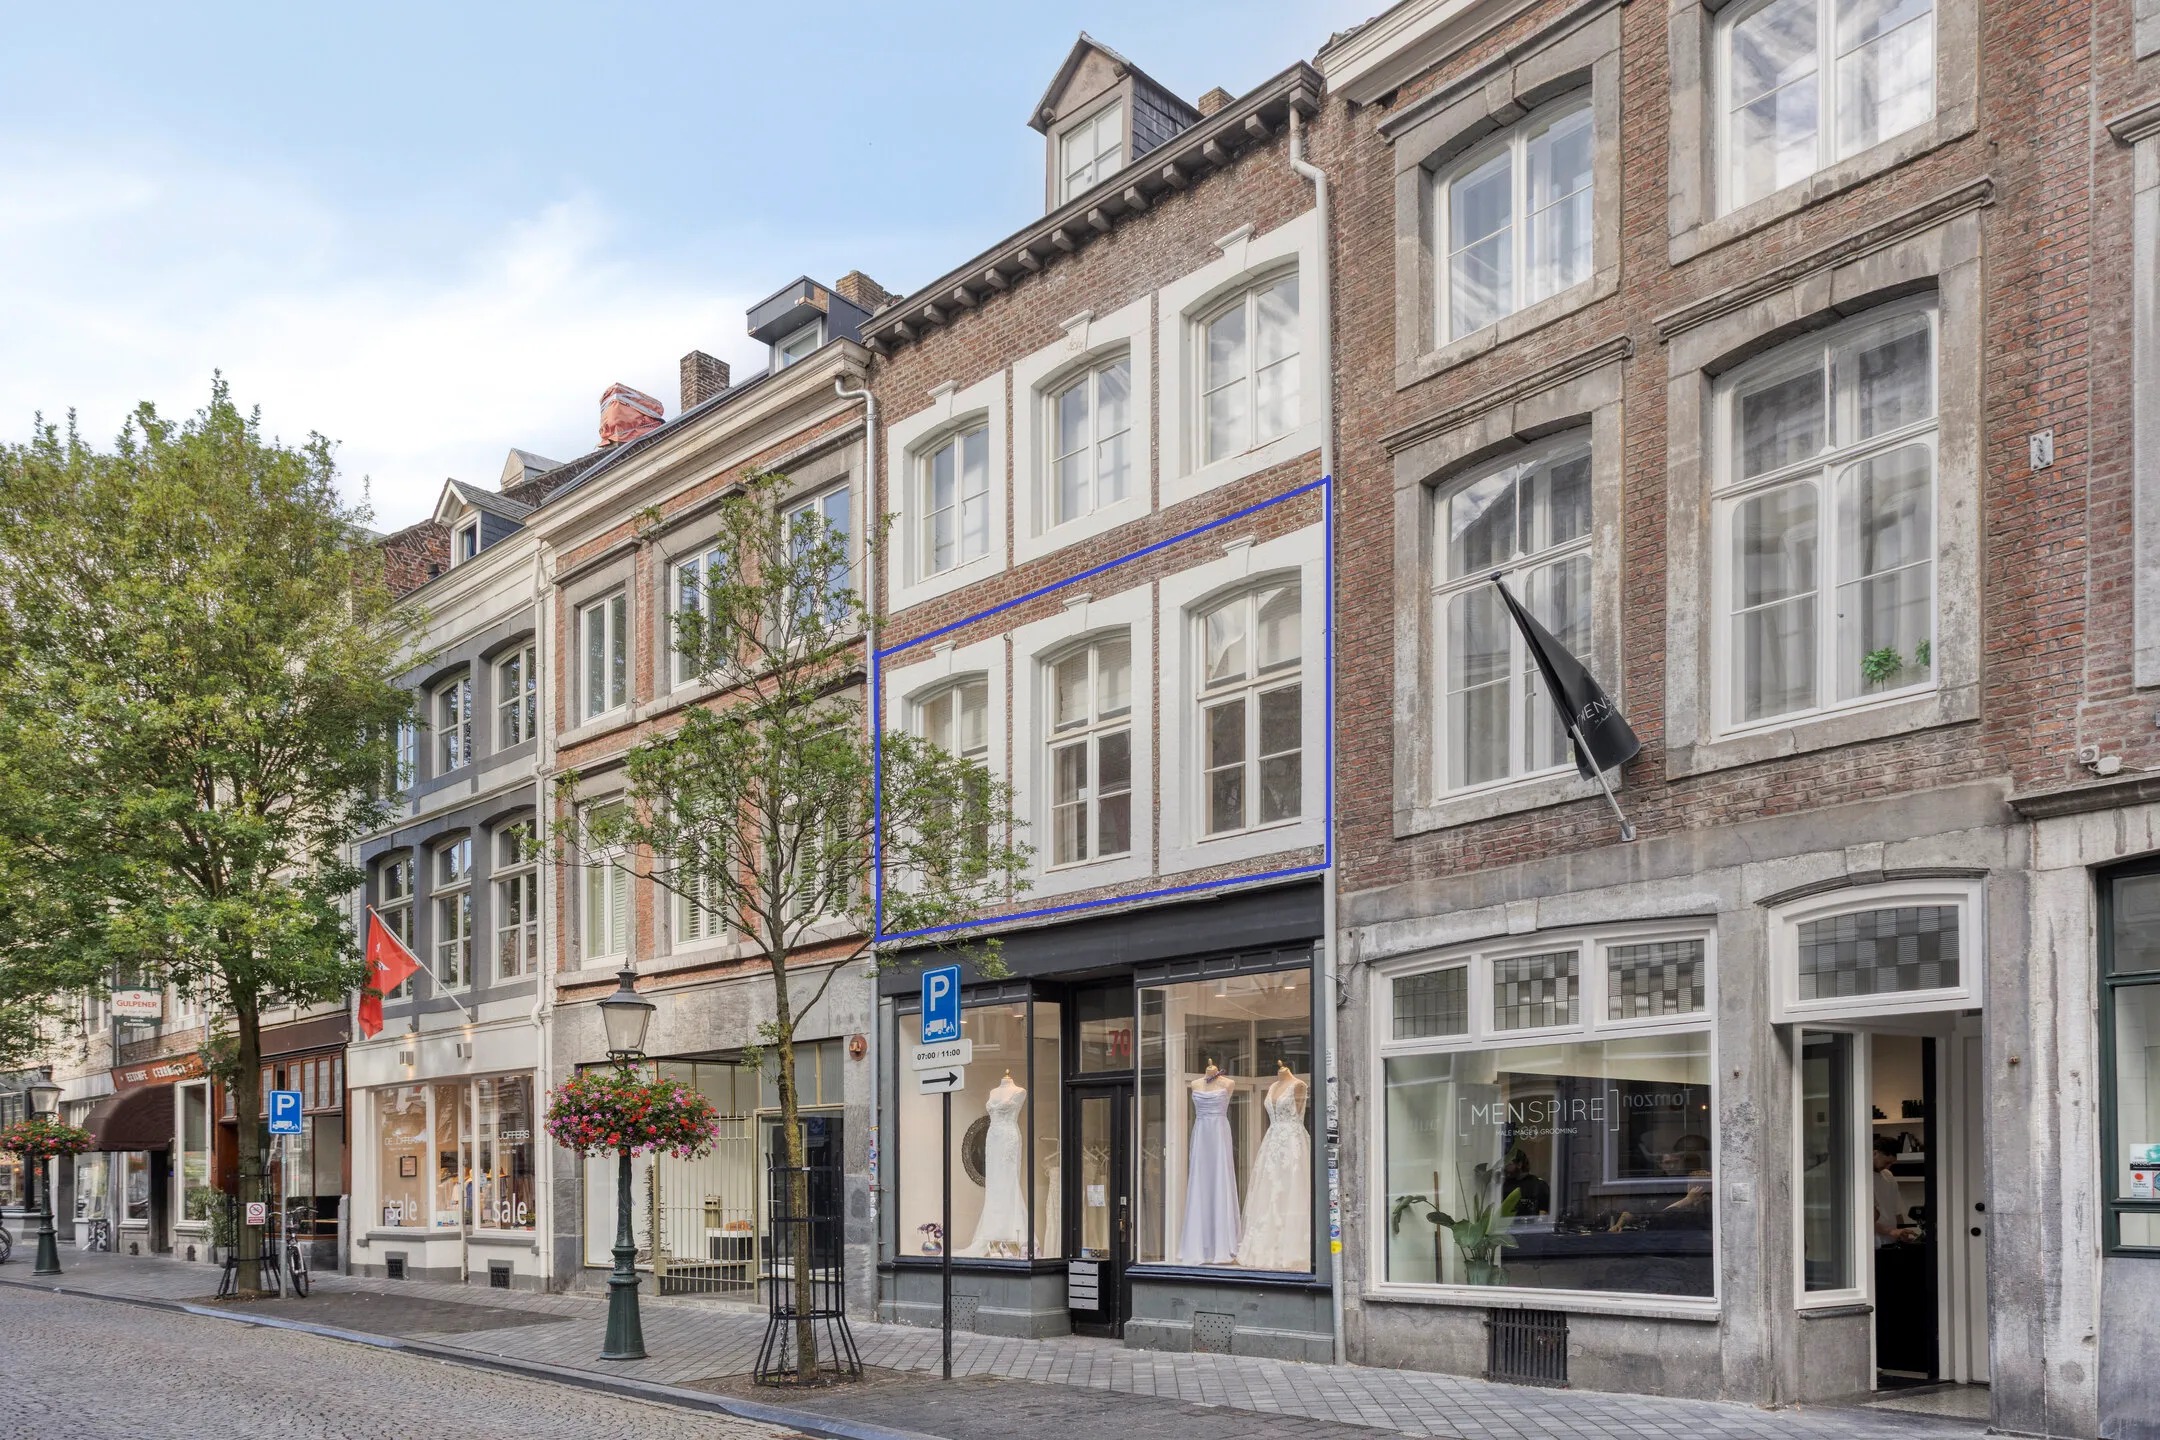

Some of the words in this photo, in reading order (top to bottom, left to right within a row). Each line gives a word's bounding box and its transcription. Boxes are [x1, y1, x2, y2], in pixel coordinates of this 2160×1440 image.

[116, 1000, 157, 1008] GULPENER
[930, 974, 950, 1012] P
[917, 1051, 936, 1061] 07:00
[941, 1048, 961, 1058] 11:00
[1109, 1029, 1131, 1057] 70
[276, 1094, 296, 1116] P
[1495, 1128, 1512, 1137] MALE
[1513, 1128, 1533, 1136] IMAGE
[1539, 1127, 1578, 1136] GROOMING
[388, 1192, 418, 1221] sale
[492, 1192, 528, 1225] sale
